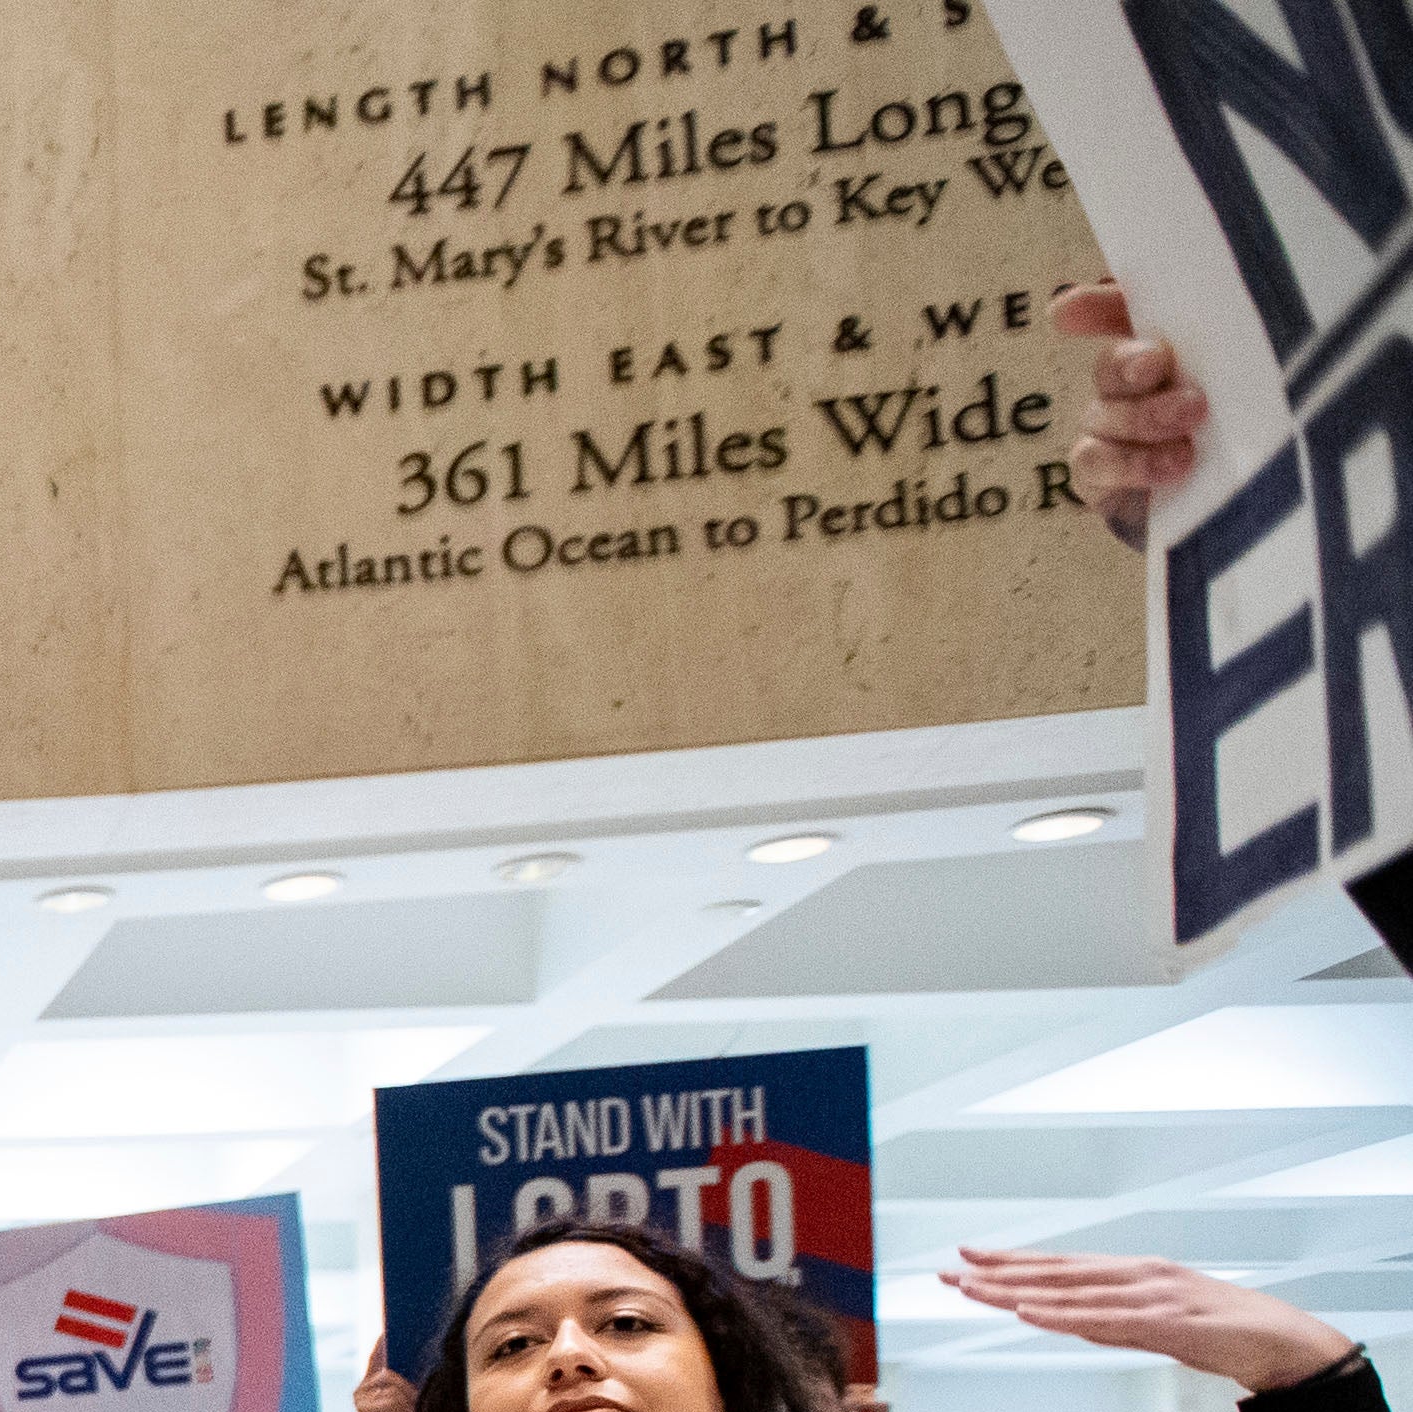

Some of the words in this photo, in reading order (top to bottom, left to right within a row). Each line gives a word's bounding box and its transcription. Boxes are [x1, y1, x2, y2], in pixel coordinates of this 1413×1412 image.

[223, 72, 492, 146] LENGTH
[540, 19, 797, 97] NORTH
[849, 4, 891, 46] &
[388, 143, 532, 218] 447
[562, 110, 779, 196] Miles
[808, 81, 1032, 147] Long
[301, 253, 368, 303] St.
[390, 223, 566, 291] Mary's
[585, 211, 735, 264] River
[754, 201, 812, 237] to
[833, 173, 949, 228] Key
[965, 146, 1069, 201] We
[319, 358, 558, 419] WIDTH
[609, 324, 781, 386] EAST
[831, 315, 872, 355] &
[922, 283, 1073, 342] WE
[396, 440, 530, 518] 361
[570, 412, 789, 495] Miles
[813, 372, 1052, 459] Wide
[272, 535, 483, 597] Atlantic
[501, 524, 682, 575] Ocean
[702, 516, 760, 552] to
[781, 472, 1010, 543] Perdido
[479, 1097, 632, 1166] STAND
[640, 1086, 766, 1153] WITH
